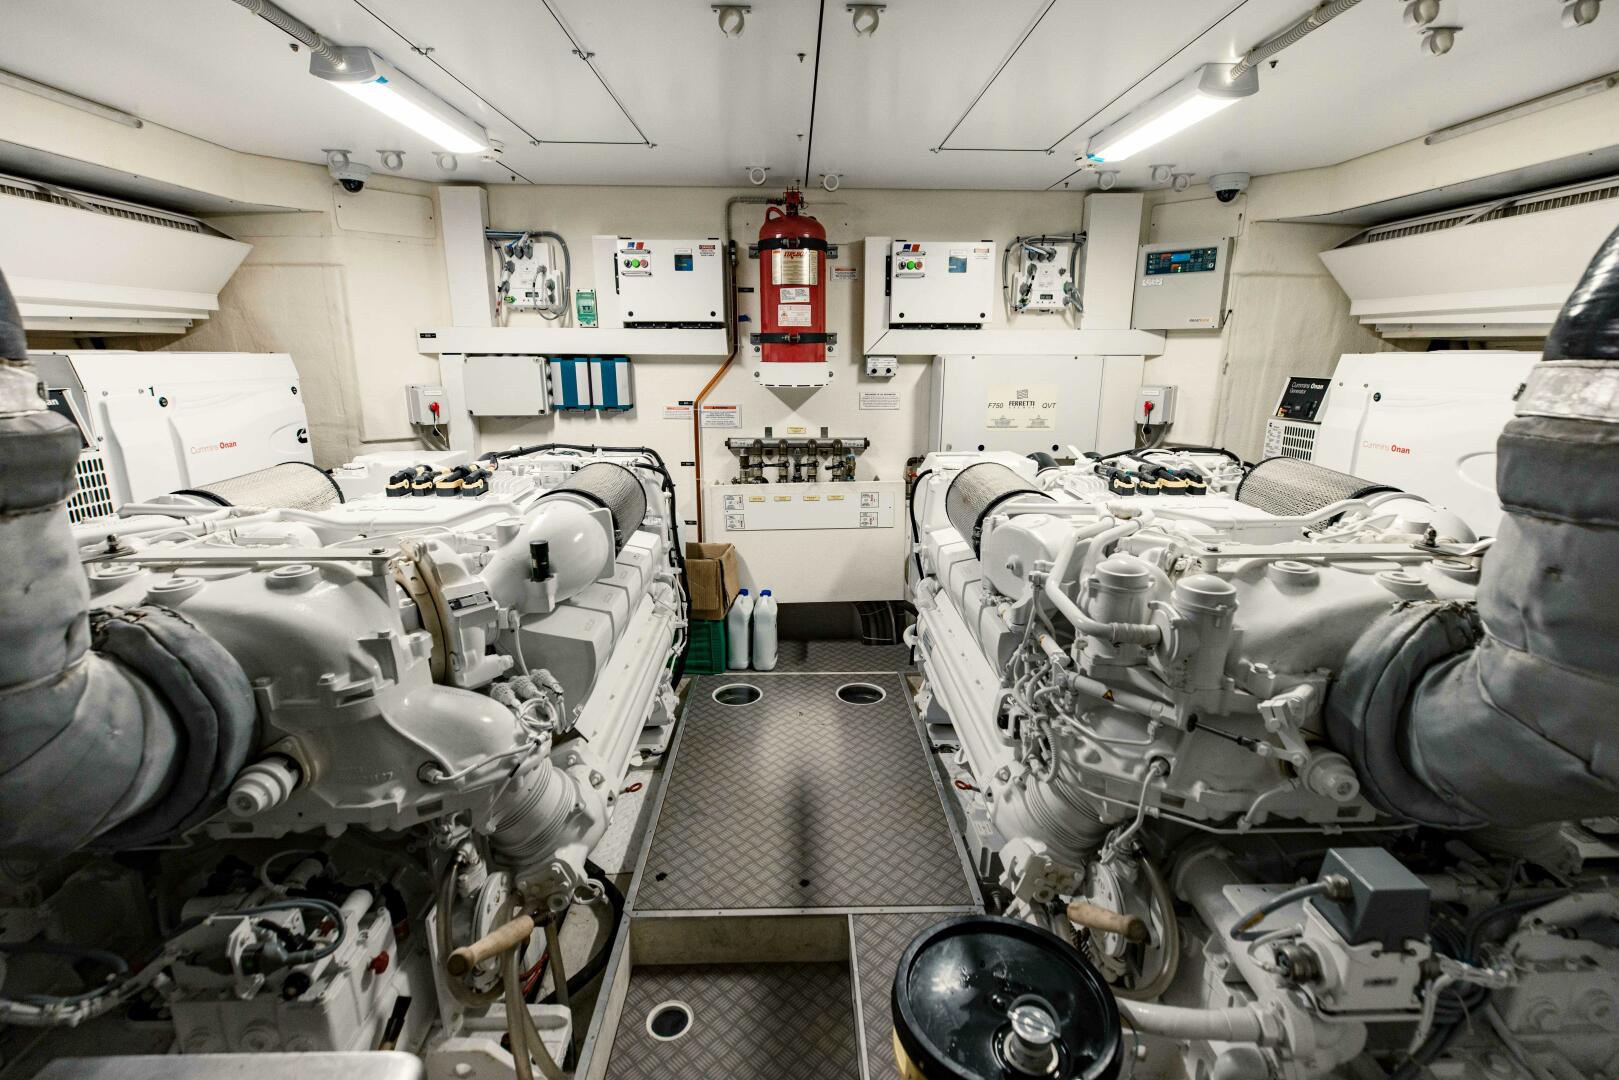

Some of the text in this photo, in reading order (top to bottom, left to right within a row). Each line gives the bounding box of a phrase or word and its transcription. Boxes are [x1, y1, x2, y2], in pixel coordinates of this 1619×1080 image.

[1311, 382, 1324, 390] Onan
[219, 441, 237, 449] Onan
[1391, 444, 1411, 454] Onan
